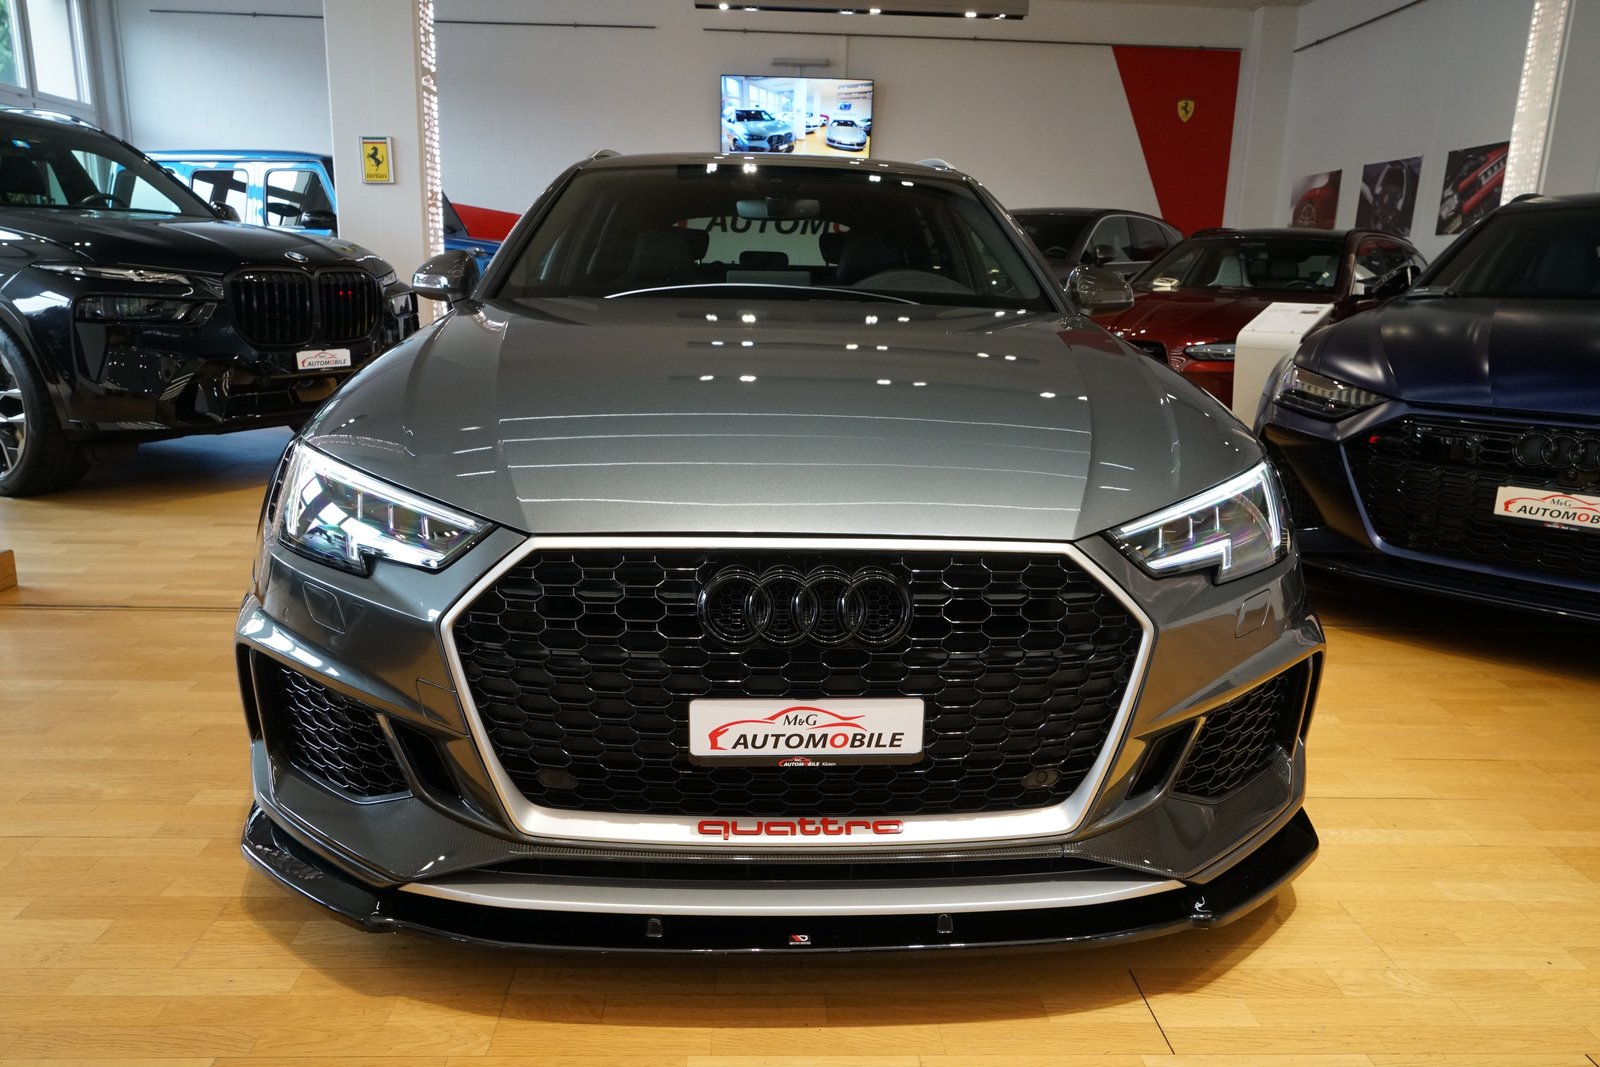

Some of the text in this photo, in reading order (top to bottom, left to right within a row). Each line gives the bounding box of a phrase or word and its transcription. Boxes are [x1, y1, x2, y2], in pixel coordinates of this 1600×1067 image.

[307, 359, 347, 367] AUTOMOBILE
[782, 713, 818, 726] M&G
[731, 732, 905, 750] AUTOMOBILE
[697, 817, 905, 841] quattro
